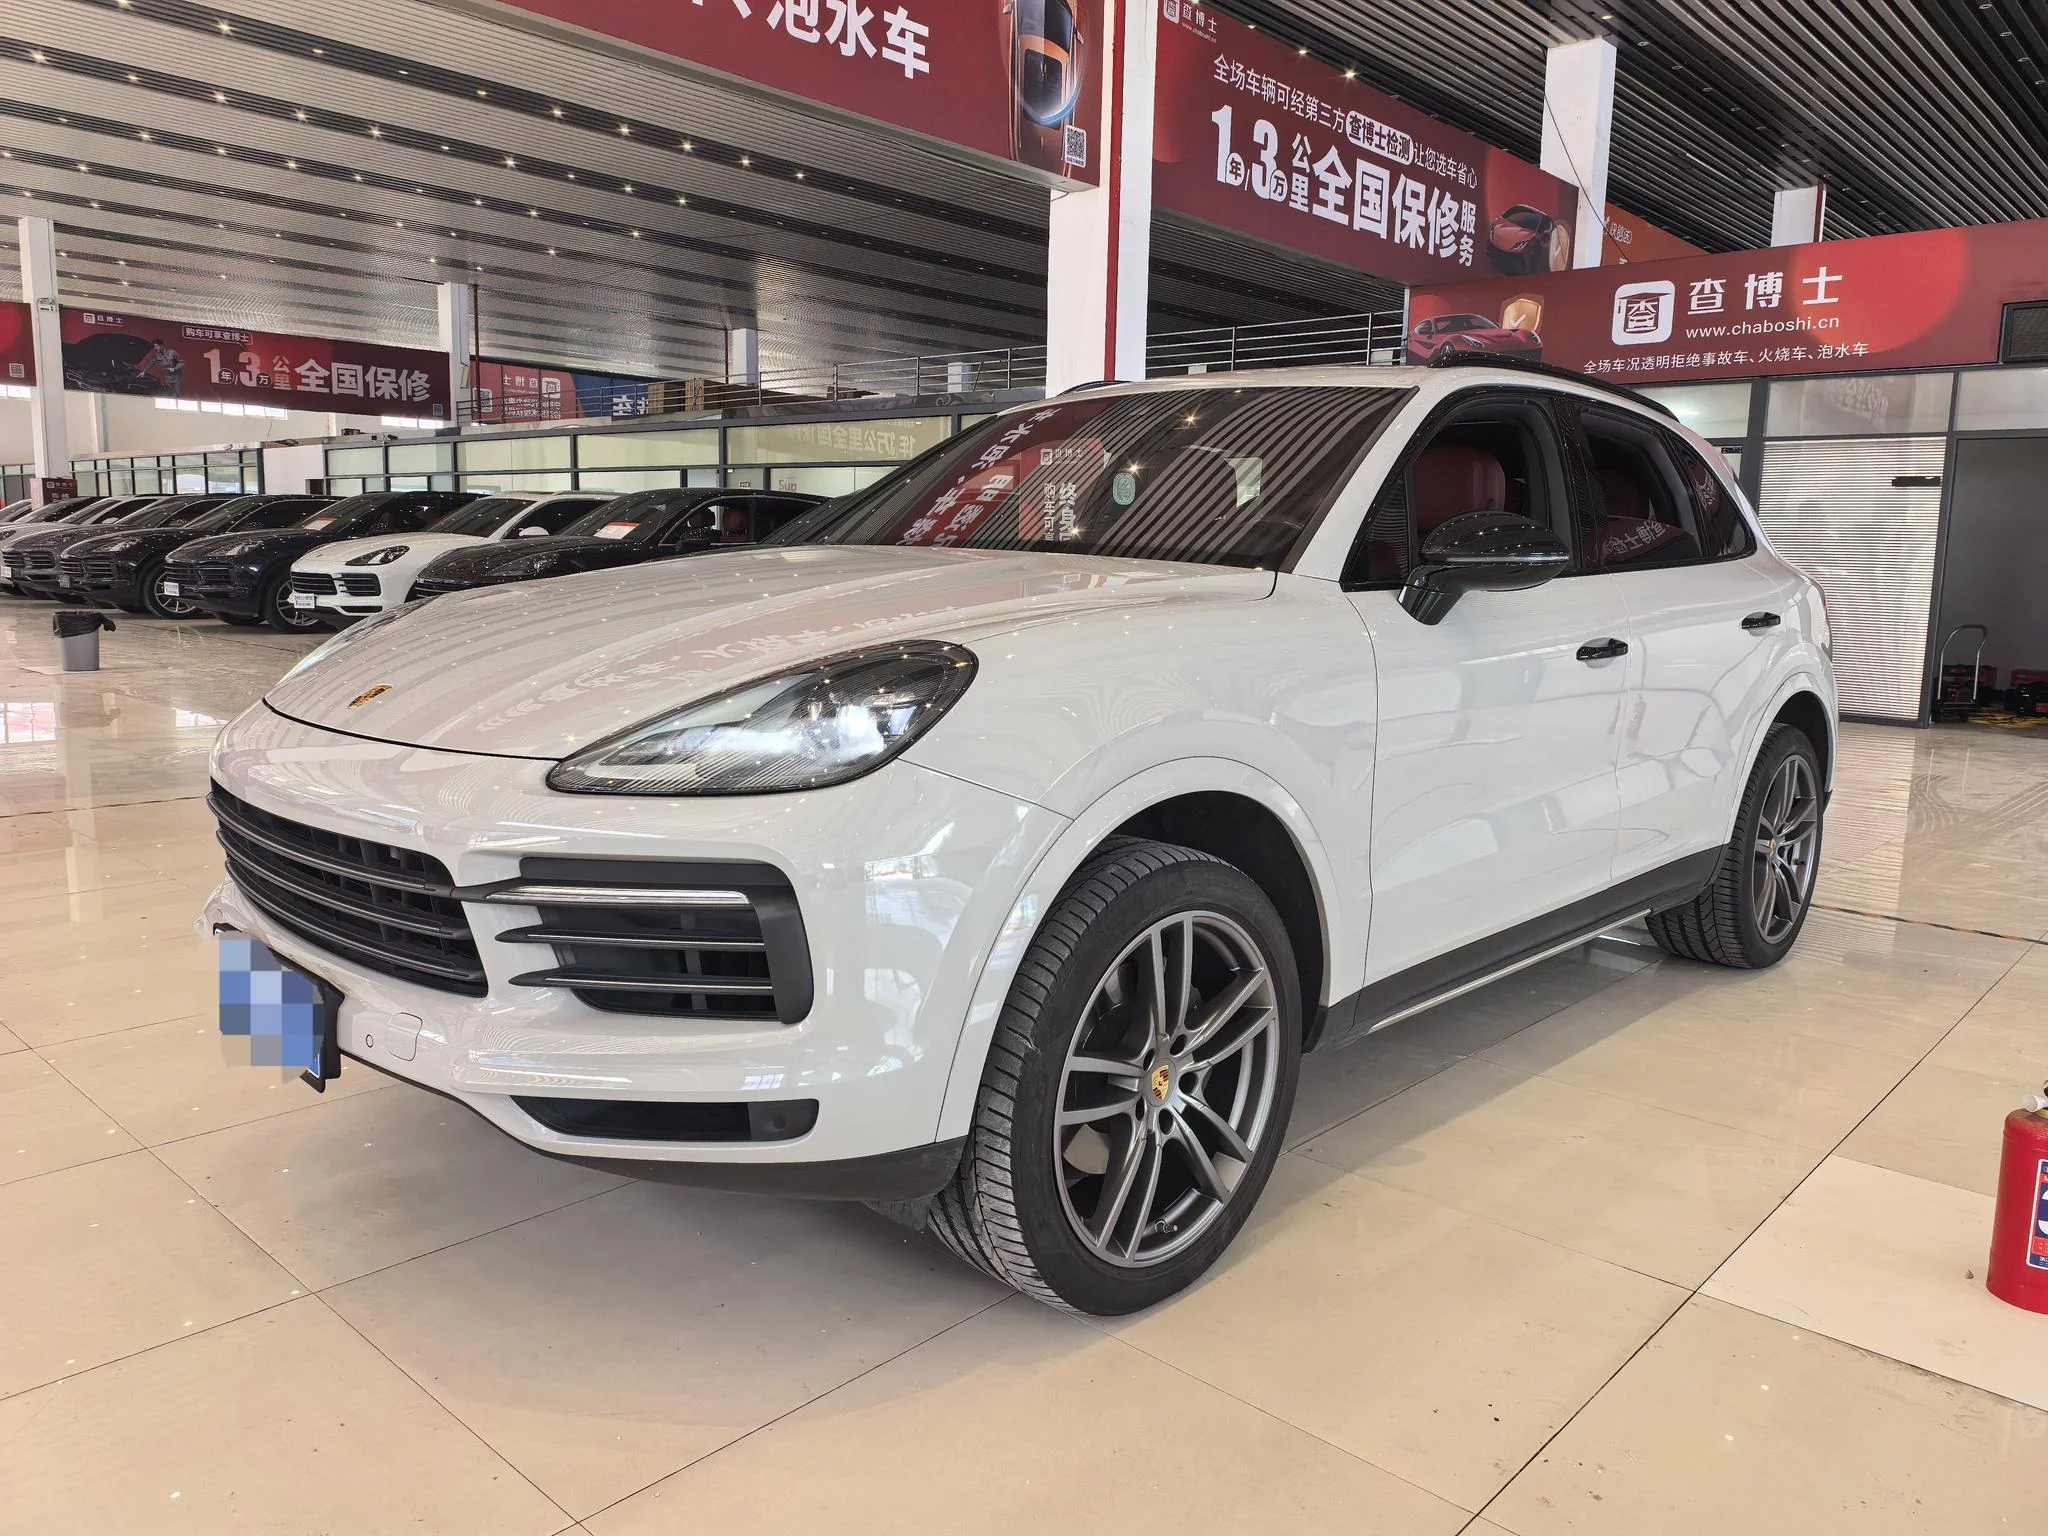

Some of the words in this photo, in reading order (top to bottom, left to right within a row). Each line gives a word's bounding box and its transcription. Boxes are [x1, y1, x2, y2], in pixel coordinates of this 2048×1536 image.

[1183, 3, 1217, 34] 查博士
[692, 0, 929, 79] 泡水车
[1687, 266, 1843, 315] 查博士
[1686, 315, 1840, 339] www.chaboshi.cn
[1583, 342, 1870, 375] 全场车况透明拒绝事故车、火烧车、泡水车
